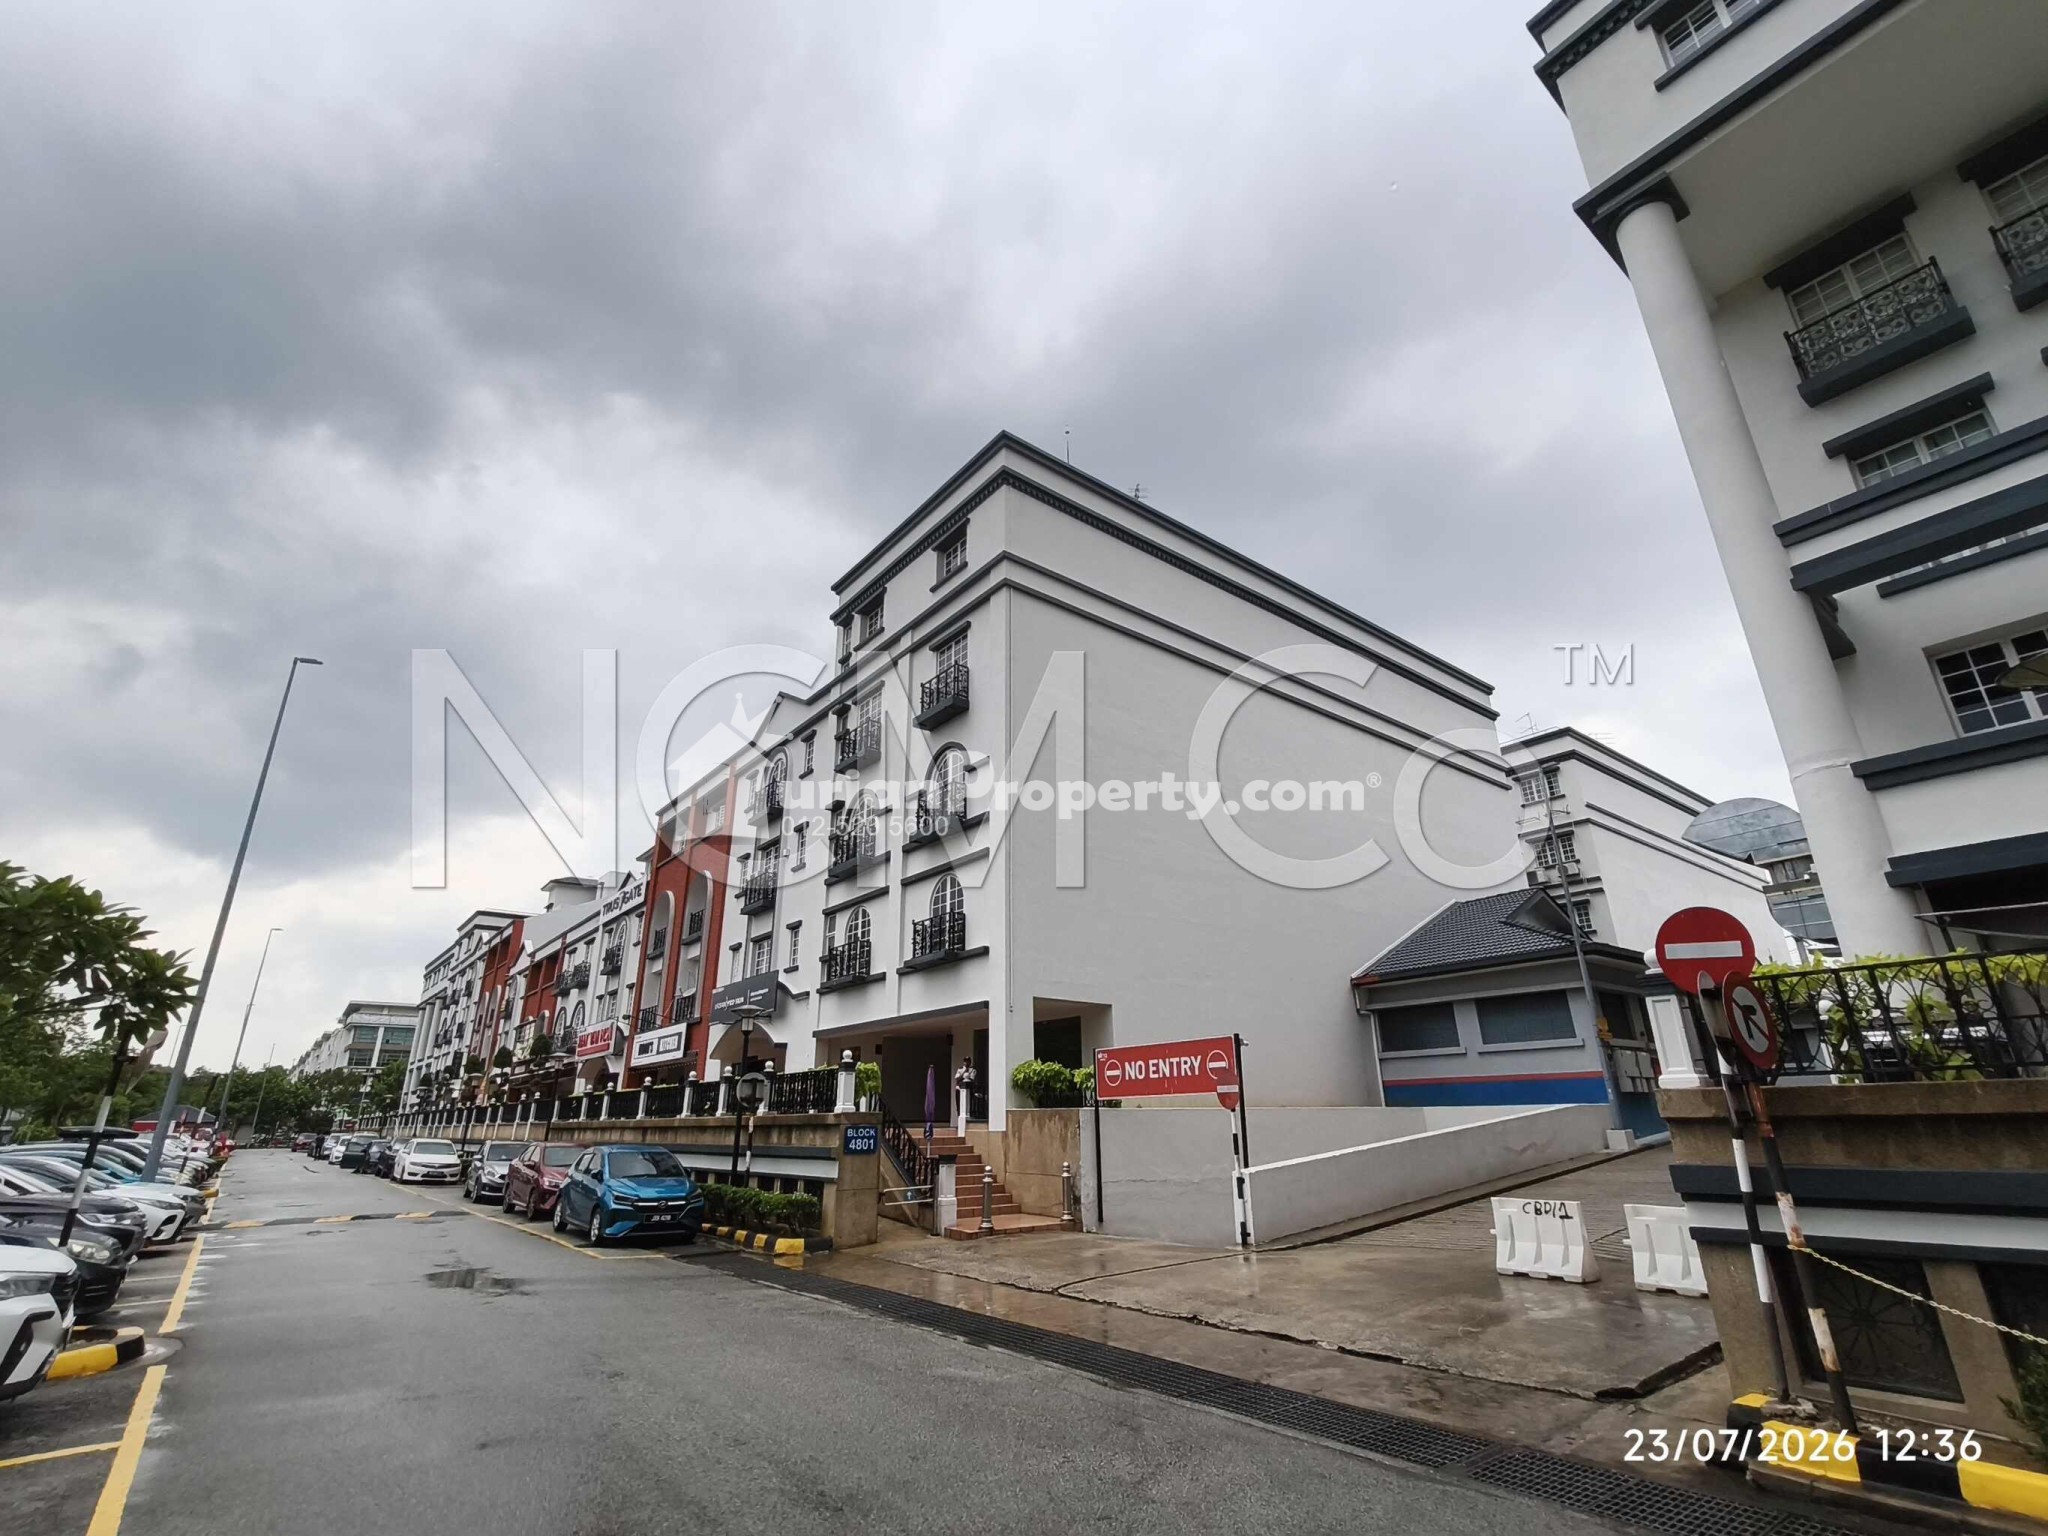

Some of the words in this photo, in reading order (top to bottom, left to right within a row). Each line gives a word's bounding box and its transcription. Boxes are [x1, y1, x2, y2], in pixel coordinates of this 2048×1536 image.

[1124, 1060, 1146, 1081] NO
[1149, 1055, 1202, 1079] ENTRY
[847, 1128, 876, 1137] BLOCK
[849, 1138, 874, 1150] 4801
